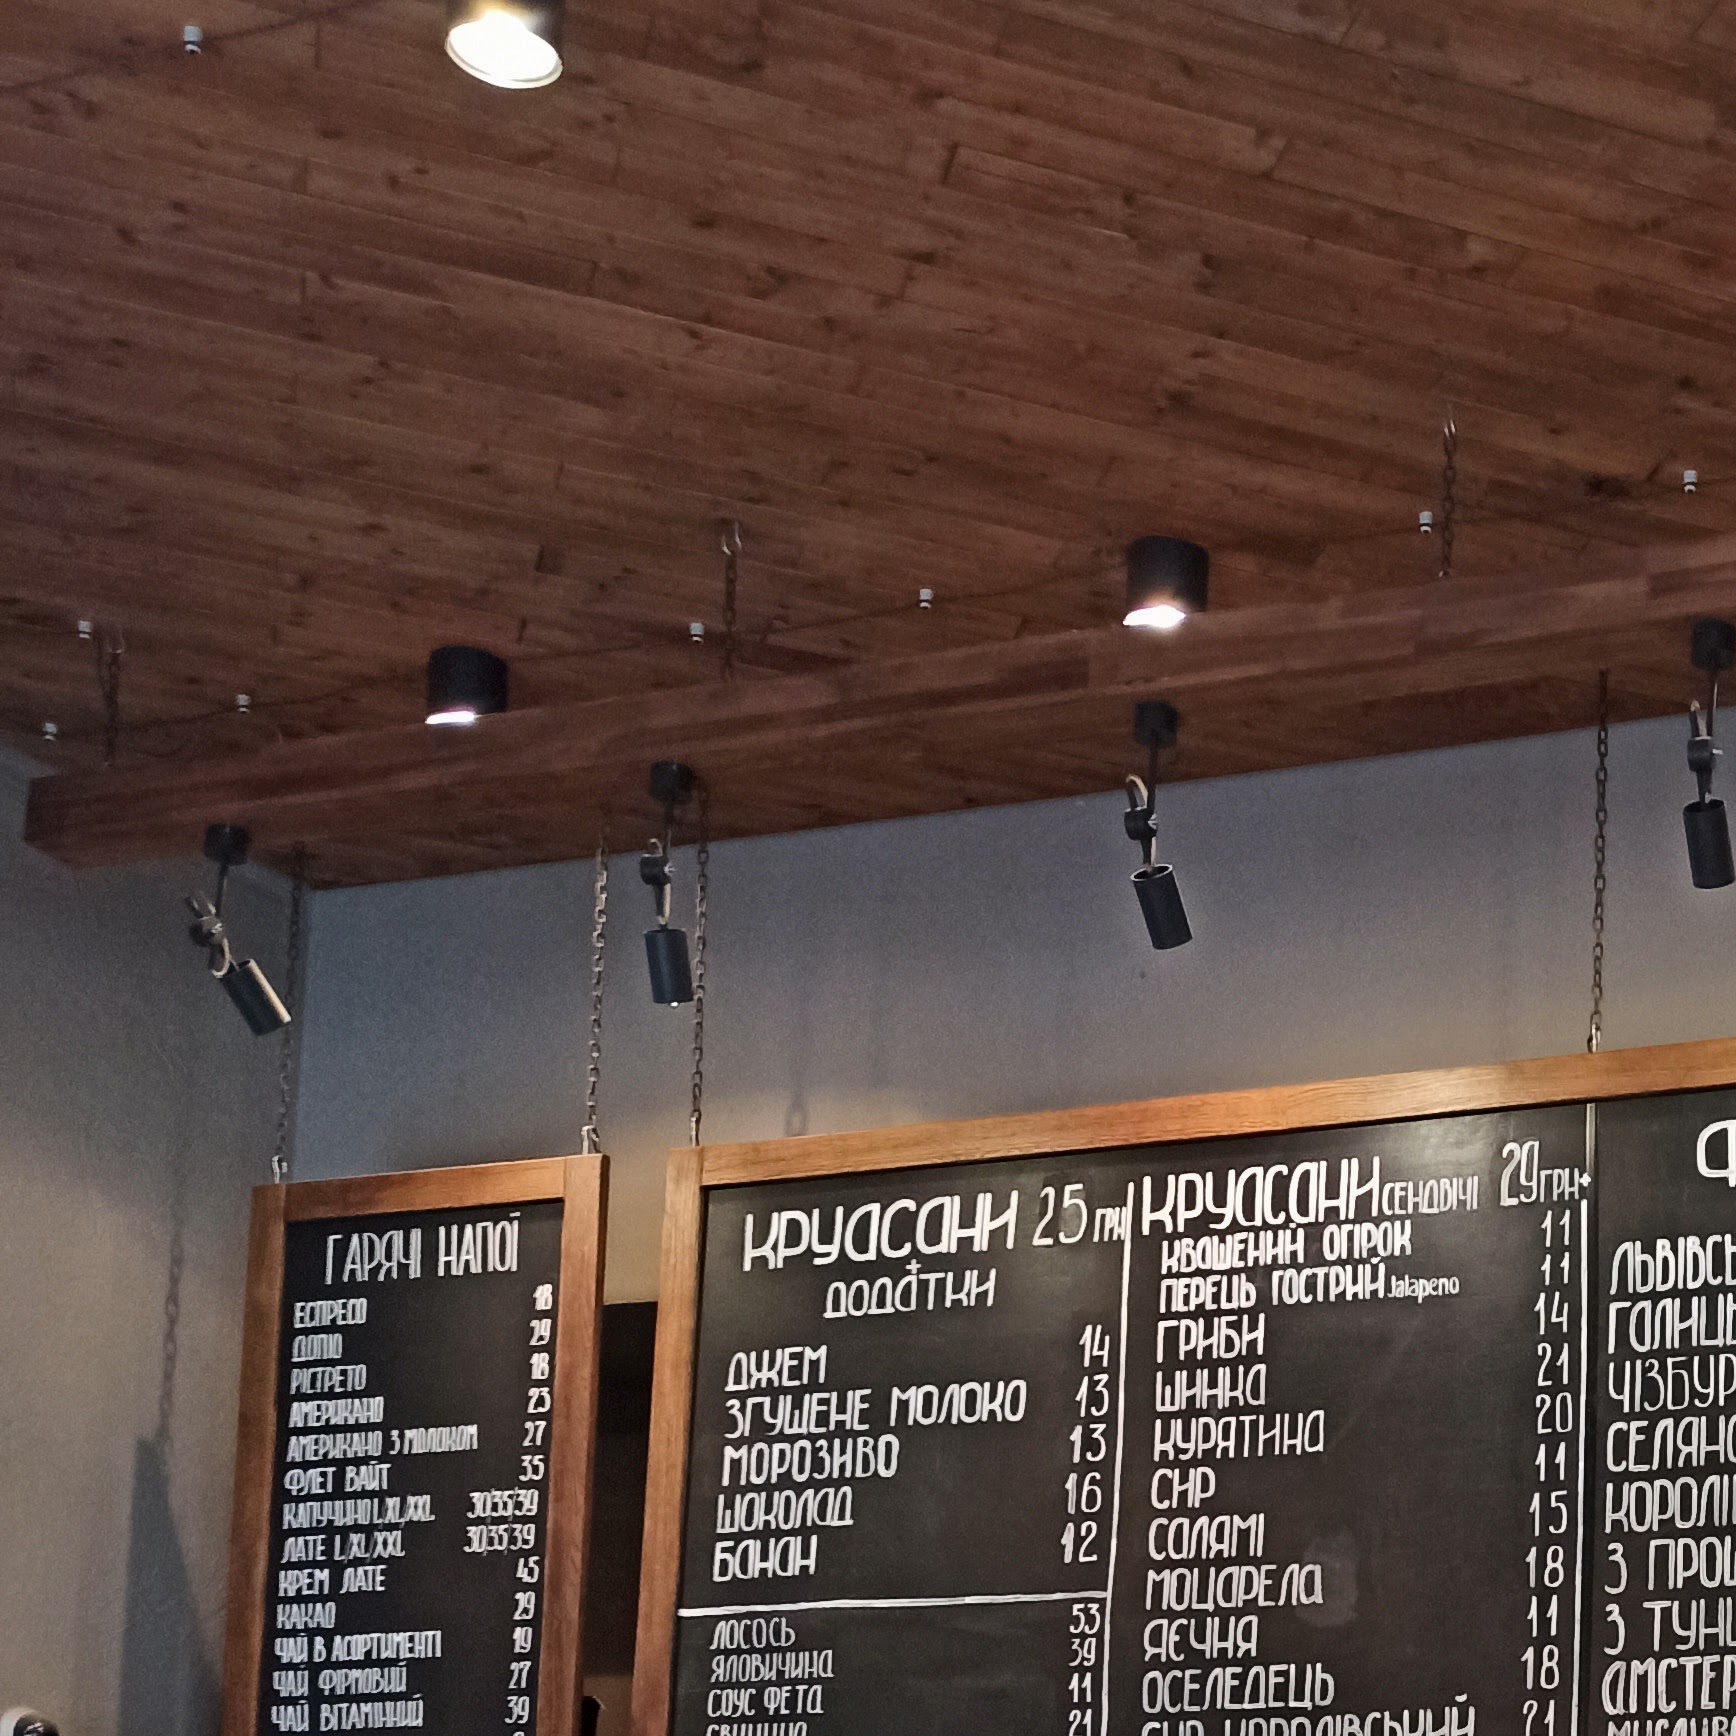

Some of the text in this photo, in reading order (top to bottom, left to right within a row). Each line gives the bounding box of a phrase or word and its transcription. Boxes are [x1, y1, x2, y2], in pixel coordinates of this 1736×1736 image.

[1142, 1156, 1379, 1236] КРУАСАНИ
[326, 1212, 520, 1286] ГАРЯЧІ НАПОЇ
[743, 1184, 1087, 1272] КРУАСАНИ 25
[1322, 1219, 1412, 1261] ОГІРОК
[823, 1268, 996, 1318] ДОДАТКИ
[1159, 1256, 1385, 1314] ПЕРЕЦЬ ГОСТРИЙ
[1388, 1274, 1460, 1303] Jalapeno
[1156, 1293, 1568, 1363] ГРИБИ 14
[291, 1365, 367, 1394] РІСТРЕТО
[725, 1324, 1109, 1391] ДЖЕМ 14
[289, 1396, 384, 1428] АМЕРИКАНО
[890, 1373, 1109, 1426] МОЛОКО 13
[1155, 1364, 1266, 1412] ШИНКА
[1154, 1393, 1572, 1461] КУРЯТИНА 20
[284, 1455, 545, 1495] ФЛЕТ ВАЙТ 35
[722, 1434, 899, 1486] МОРОЗИВО
[716, 1472, 1102, 1534] ШОКОЛАД 16
[1150, 1466, 1215, 1509] СИР
[1148, 1491, 1568, 1560] САЛЯМІ 15
[279, 1556, 540, 1596] КРЕМ 45
[712, 1520, 1098, 1582] БАНАН 12
[276, 1602, 336, 1629] КАКАО
[710, 1617, 796, 1650] ЛОСОСЬ
[274, 1630, 442, 1662] ЧАЙ АСОРТИМЕНТІ
[711, 1637, 1096, 1683] ЯЛОВИЧИНА 39
[272, 1661, 531, 1697] ЧАЙ ФІРМОВИЙ 27
[1142, 1645, 1560, 1714] ОСЕЛЕДЕЦЬ 18
